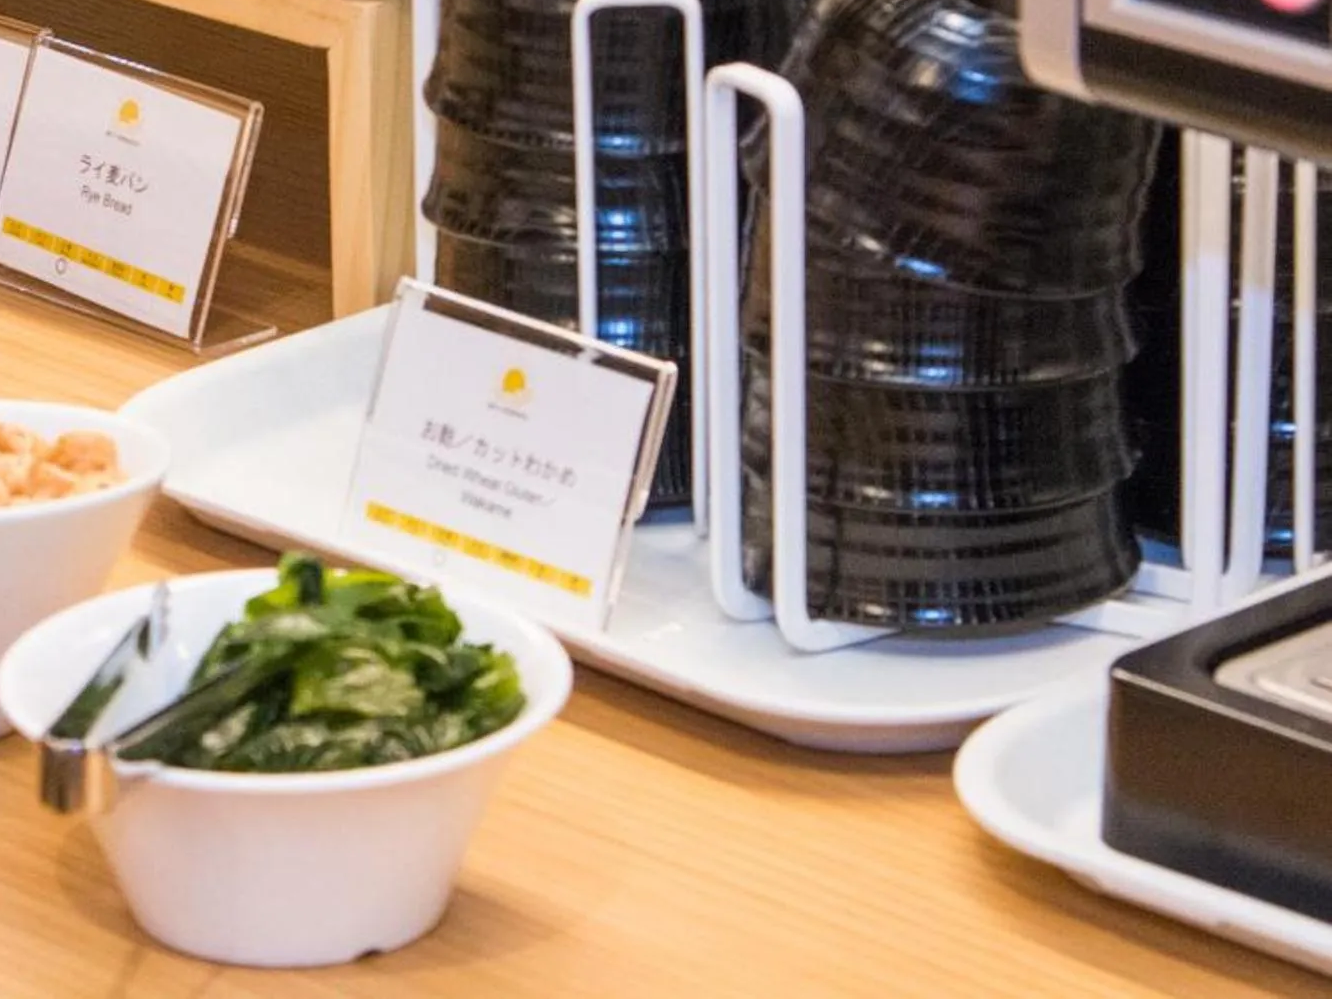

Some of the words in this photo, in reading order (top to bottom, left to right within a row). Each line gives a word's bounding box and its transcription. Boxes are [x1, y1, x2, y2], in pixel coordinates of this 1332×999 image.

[79, 154, 149, 193] ライ麦パン
[81, 185, 101, 204] Rye
[102, 193, 133, 216] Bread
